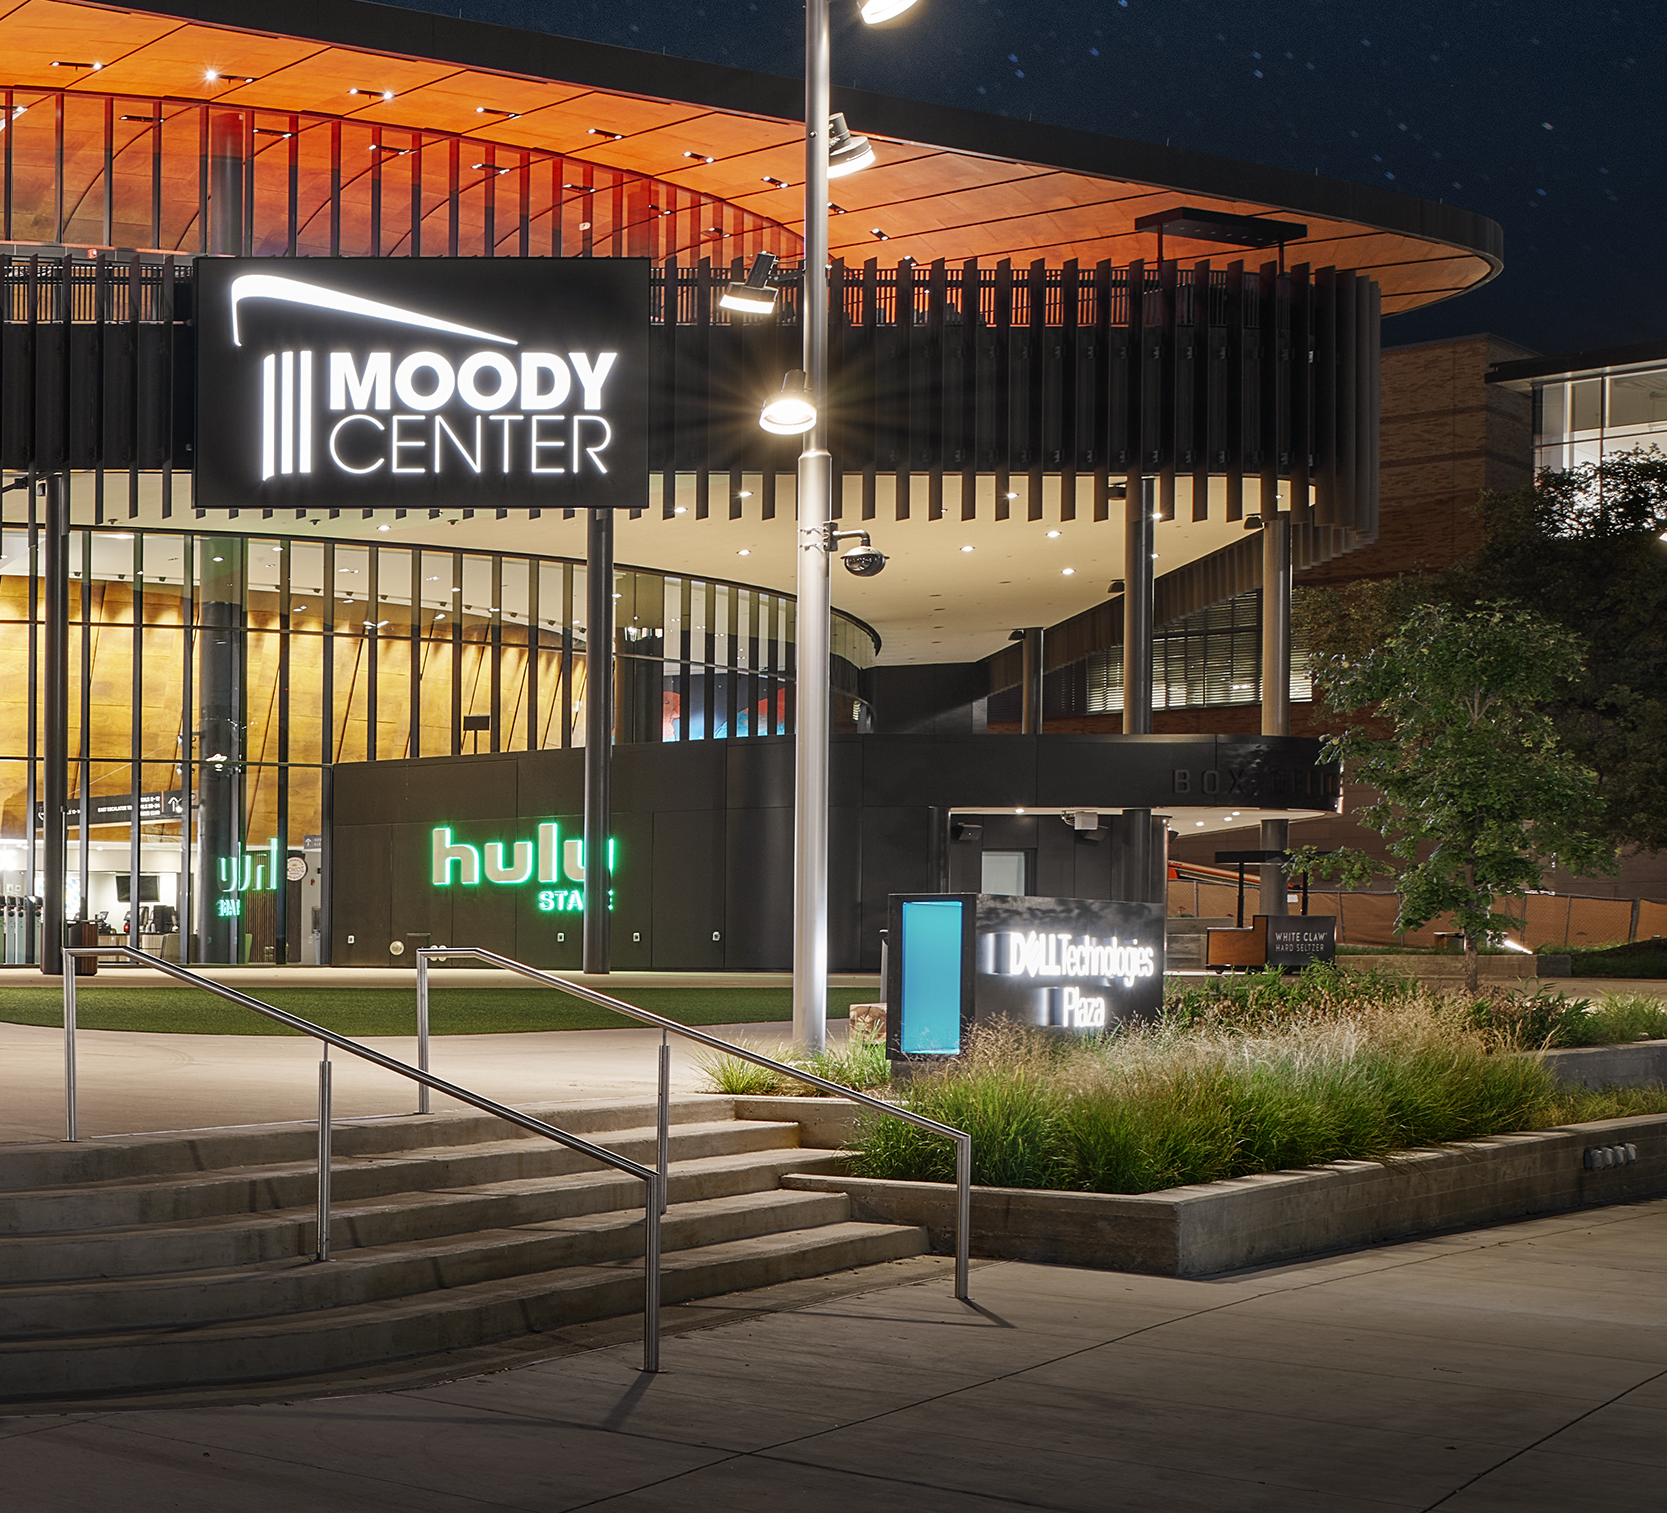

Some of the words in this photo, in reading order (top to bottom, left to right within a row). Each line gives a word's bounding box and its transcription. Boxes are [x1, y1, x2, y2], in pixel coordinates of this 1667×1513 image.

[329, 351, 617, 411] MOODY
[329, 414, 612, 474] CENTER
[1173, 769, 1244, 795] BOX
[538, 889, 614, 911] STA
[1275, 932, 1301, 942] WHITE
[1303, 932, 1325, 942] CLAW
[1275, 943, 1294, 952] HARD
[1296, 943, 1325, 952] SELTZER
[1009, 931, 1061, 977] DELL
[1058, 935, 1154, 987] Technologies
[1062, 986, 1106, 1028] Plaza
